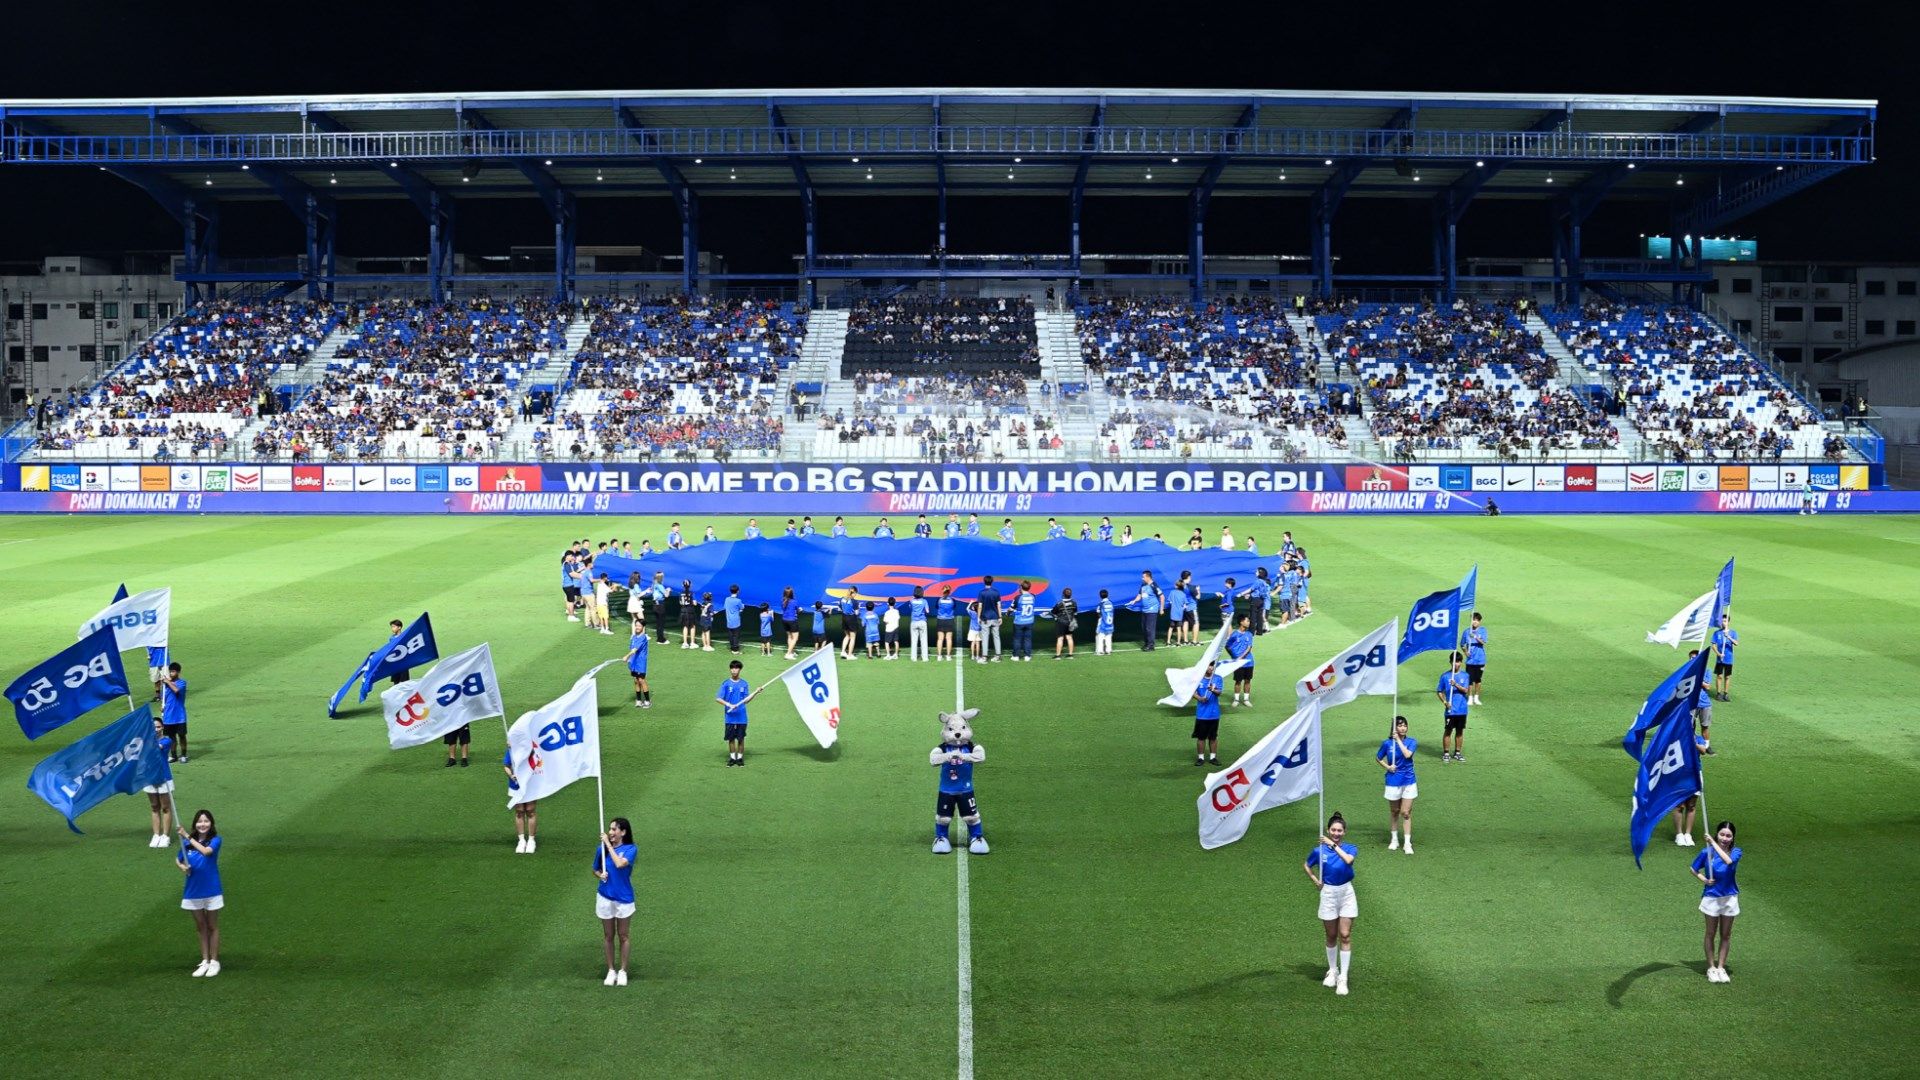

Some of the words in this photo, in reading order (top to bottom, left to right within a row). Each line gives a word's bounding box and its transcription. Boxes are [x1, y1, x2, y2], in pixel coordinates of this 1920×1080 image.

[455, 477, 473, 486] BG
[499, 482, 522, 491] LEO
[564, 471, 743, 492] WELCOME
[750, 471, 799, 492] TO
[807, 467, 865, 492] BG
[871, 471, 1038, 492] STADIUM
[1048, 471, 1157, 492] HOME
[1165, 471, 1215, 492] OF
[1222, 471, 1323, 492] BGPU
[1364, 482, 1388, 491] LEO
[70, 493, 102, 510] PISAN
[104, 493, 179, 510] DOKMAIKAEW
[187, 493, 202, 510] 93
[471, 493, 505, 510] PISAN
[508, 493, 586, 510] DOKMAIKAEW
[594, 493, 610, 510] 93
[890, 493, 924, 510] PISAN
[928, 493, 1007, 511] DOKMAIKAEW
[1016, 493, 1032, 510] 93
[1311, 492, 1346, 510] PISAN
[1349, 492, 1427, 510] DOKMAIKAEW
[1435, 492, 1451, 509] 93
[1719, 492, 1753, 509] PISAN
[1836, 492, 1851, 509] 93
[1021, 604, 1034, 617] 10
[802, 662, 829, 703] BG
